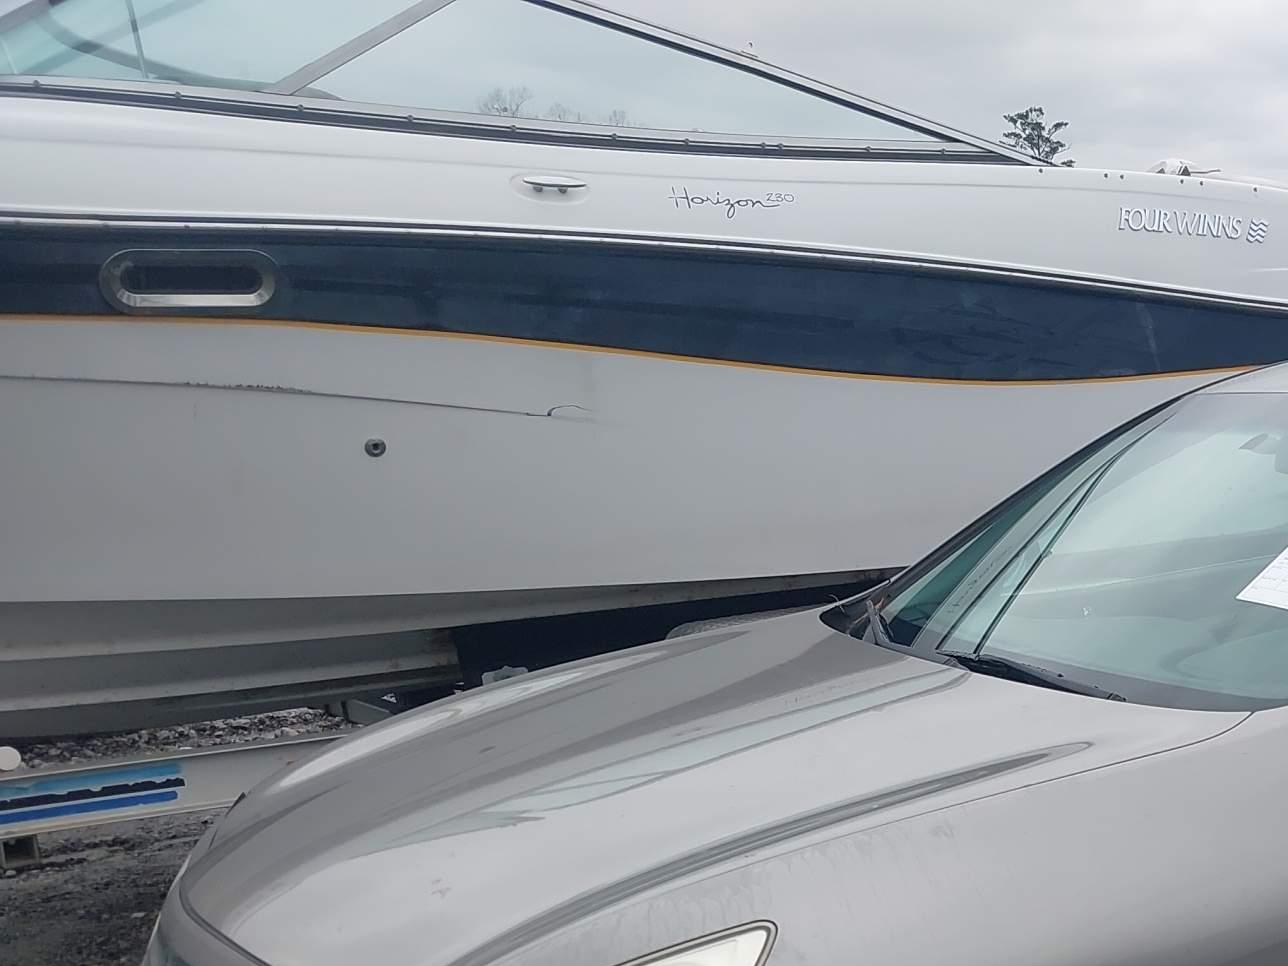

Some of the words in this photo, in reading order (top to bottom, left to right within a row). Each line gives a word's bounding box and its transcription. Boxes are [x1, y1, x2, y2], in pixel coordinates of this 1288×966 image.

[668, 186, 780, 219] Horizon
[1118, 207, 1172, 233] FOUR
[1173, 210, 1242, 240] WINNS
